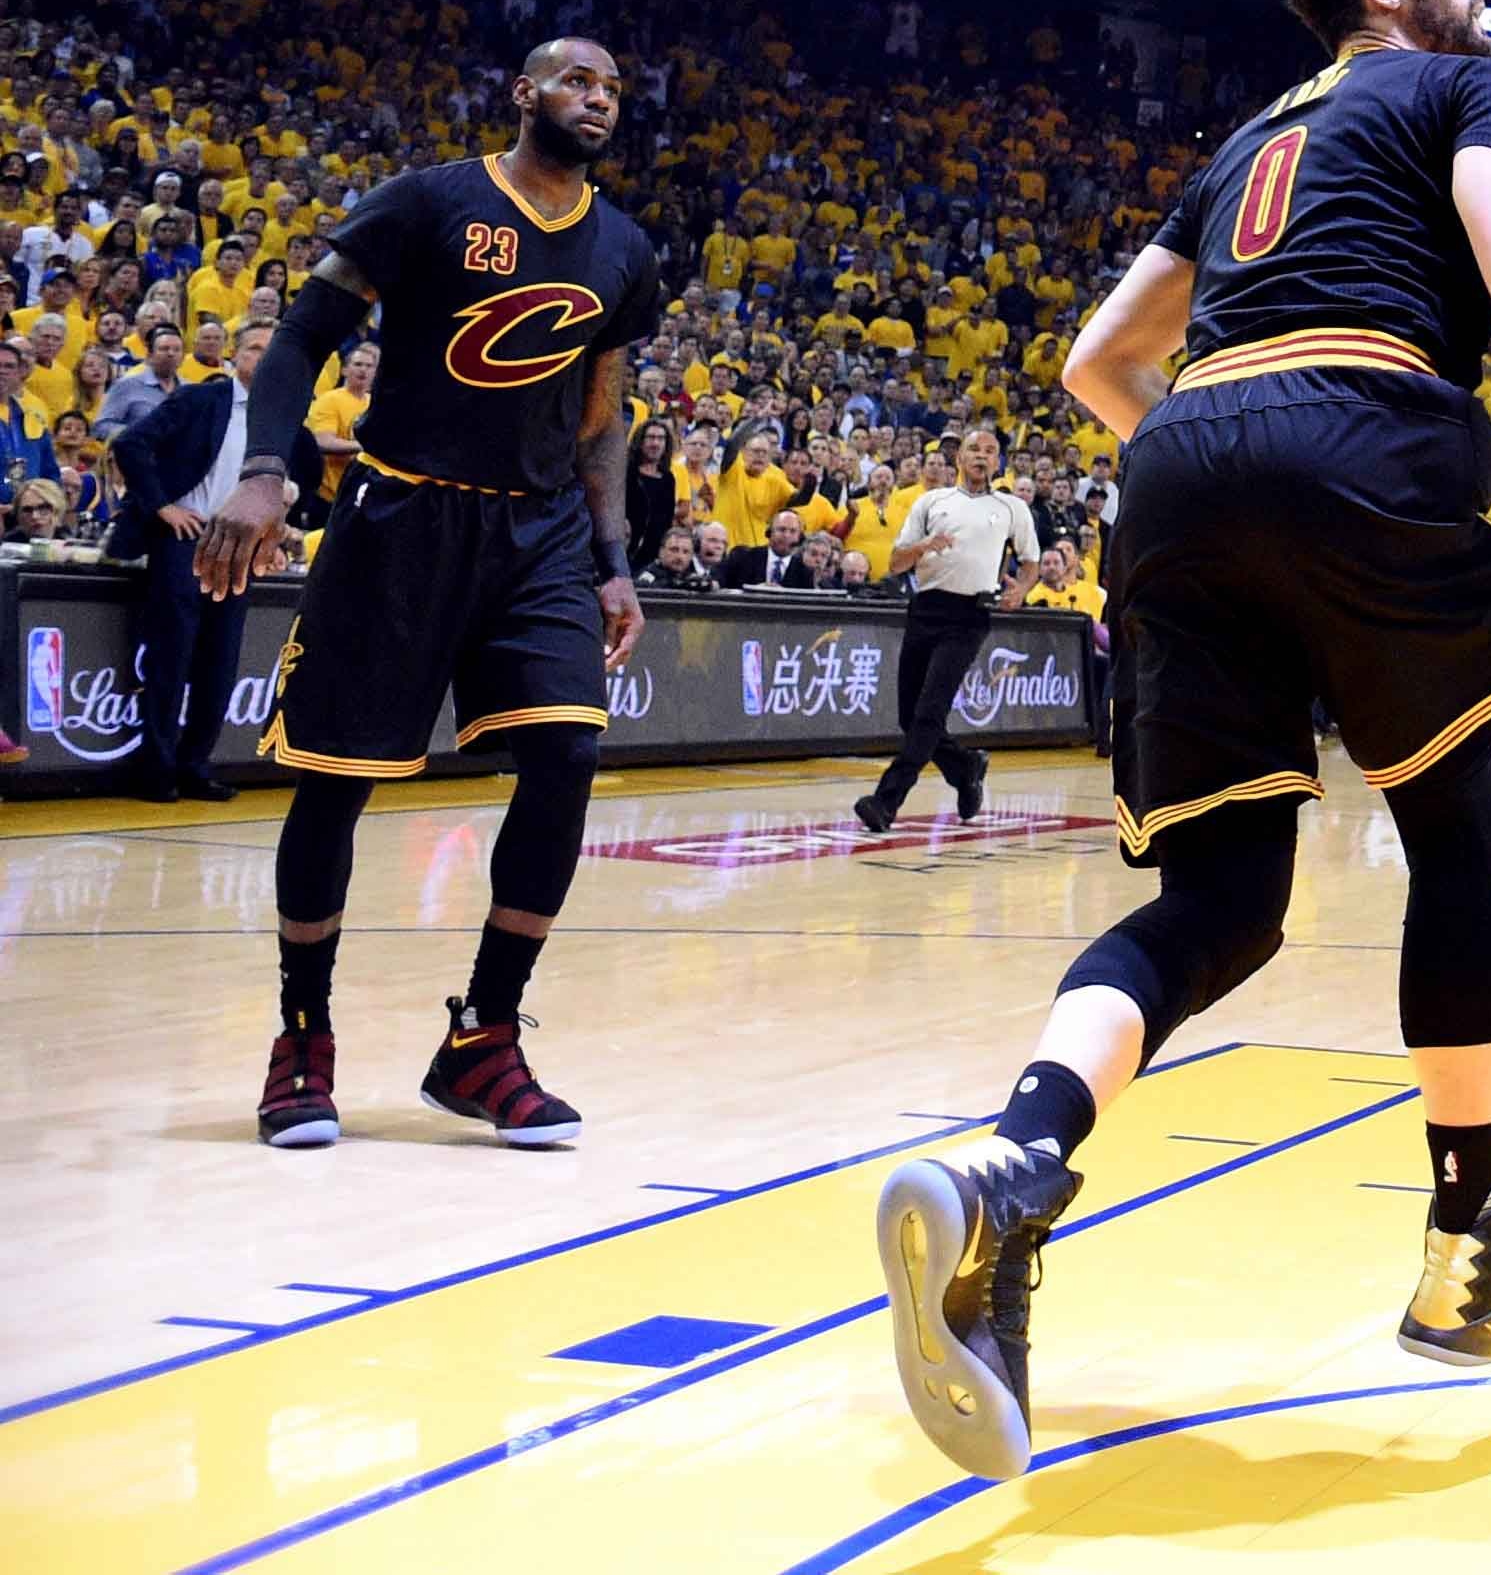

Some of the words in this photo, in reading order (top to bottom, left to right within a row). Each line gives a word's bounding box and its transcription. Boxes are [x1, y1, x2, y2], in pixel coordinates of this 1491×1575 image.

[1231, 124, 1309, 263] 0
[463, 222, 520, 276] 23
[762, 641, 884, 716] 总决赛
[960, 647, 1080, 727] Finales
